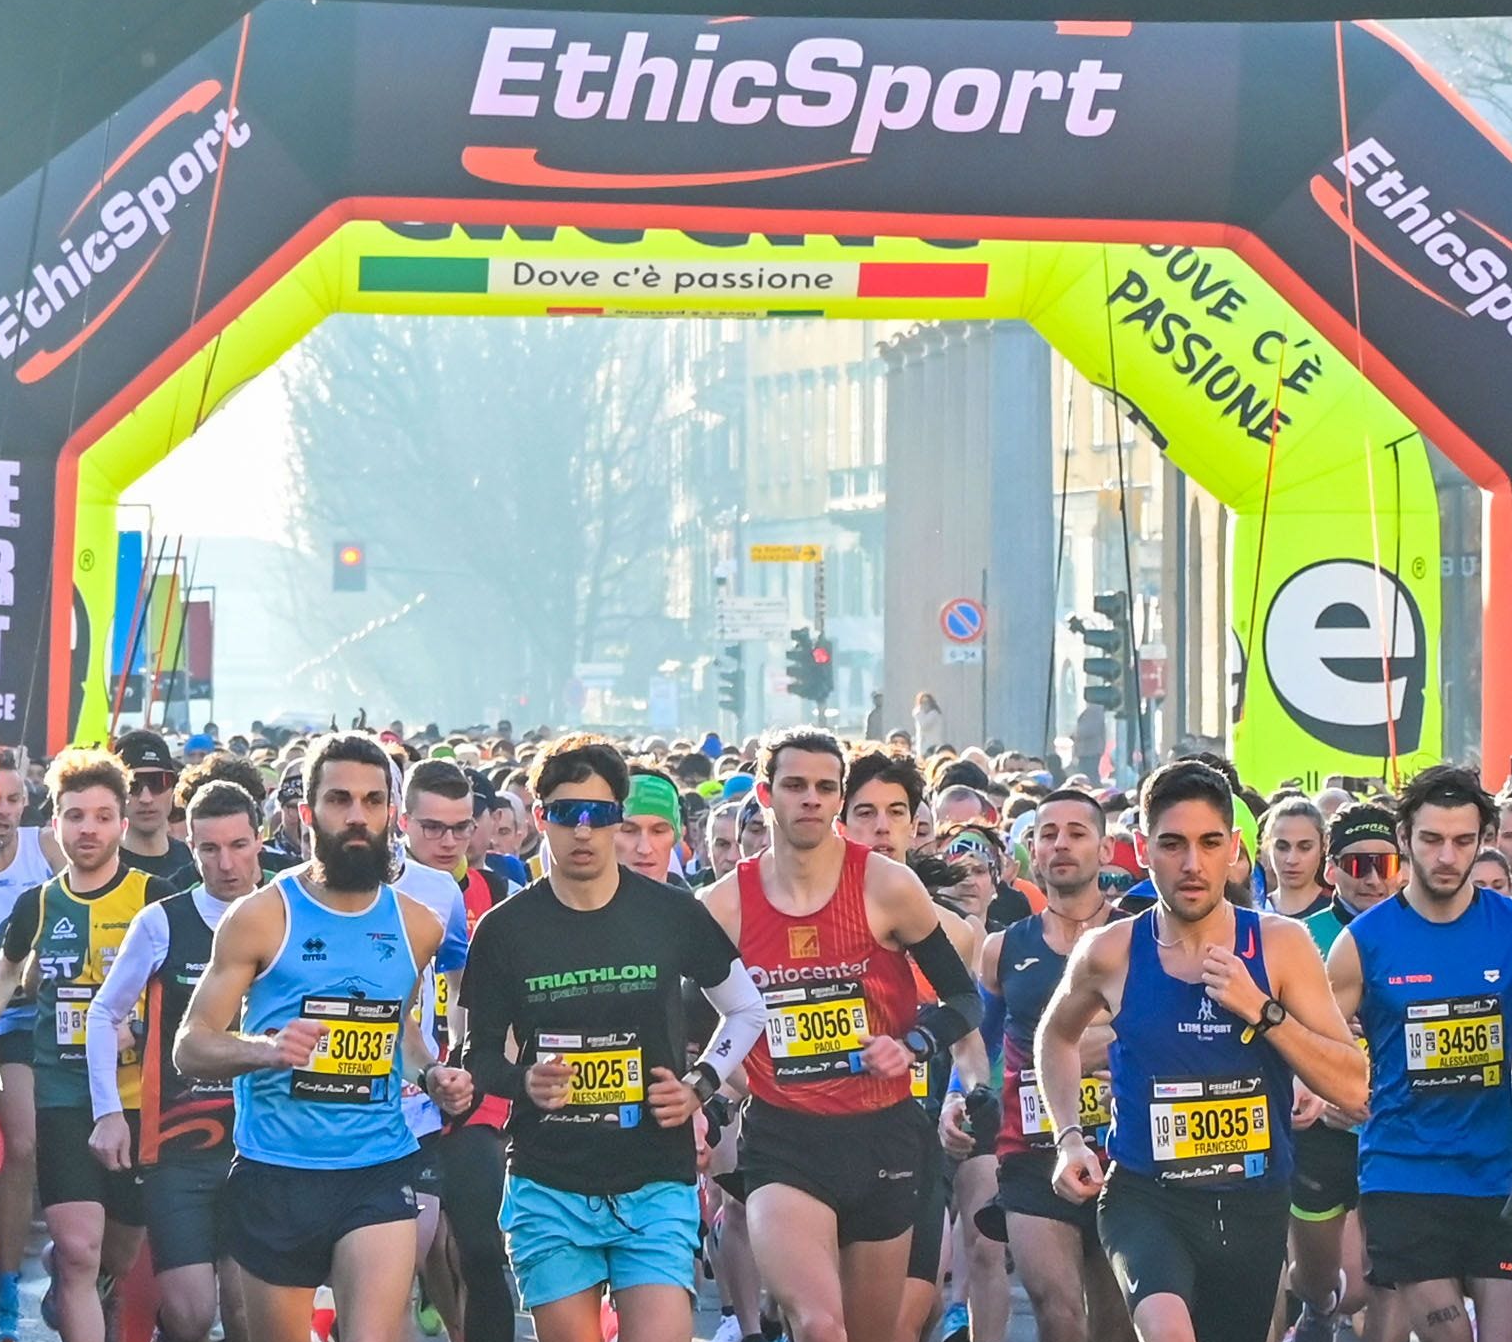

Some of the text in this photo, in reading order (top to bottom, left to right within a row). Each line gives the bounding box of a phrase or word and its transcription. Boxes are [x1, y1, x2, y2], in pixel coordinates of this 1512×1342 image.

[469, 26, 1122, 154] EthicSport
[513, 261, 596, 289] Dove
[674, 269, 834, 294] passione
[1106, 269, 1292, 445] PASSIONE
[525, 965, 657, 991] TRIATHLON
[768, 1018, 782, 1036] 10
[798, 1008, 851, 1042] 3056
[331, 1029, 383, 1061] 3033
[814, 1040, 841, 1054] PAOLO
[1409, 1033, 1422, 1049] 10
[1438, 1025, 1488, 1055] 3456
[338, 1062, 373, 1075] STEFANO
[1440, 1053, 1490, 1068] ALESSANDRO
[571, 1059, 624, 1090] 3025
[571, 1090, 627, 1104] ALESSANDRO
[1023, 1096, 1036, 1111] 10
[625, 1110, 632, 1122] 1
[1155, 1116, 1170, 1134] 10
[1190, 1107, 1249, 1141] 3035
[1194, 1138, 1248, 1154] FRANCESCO
